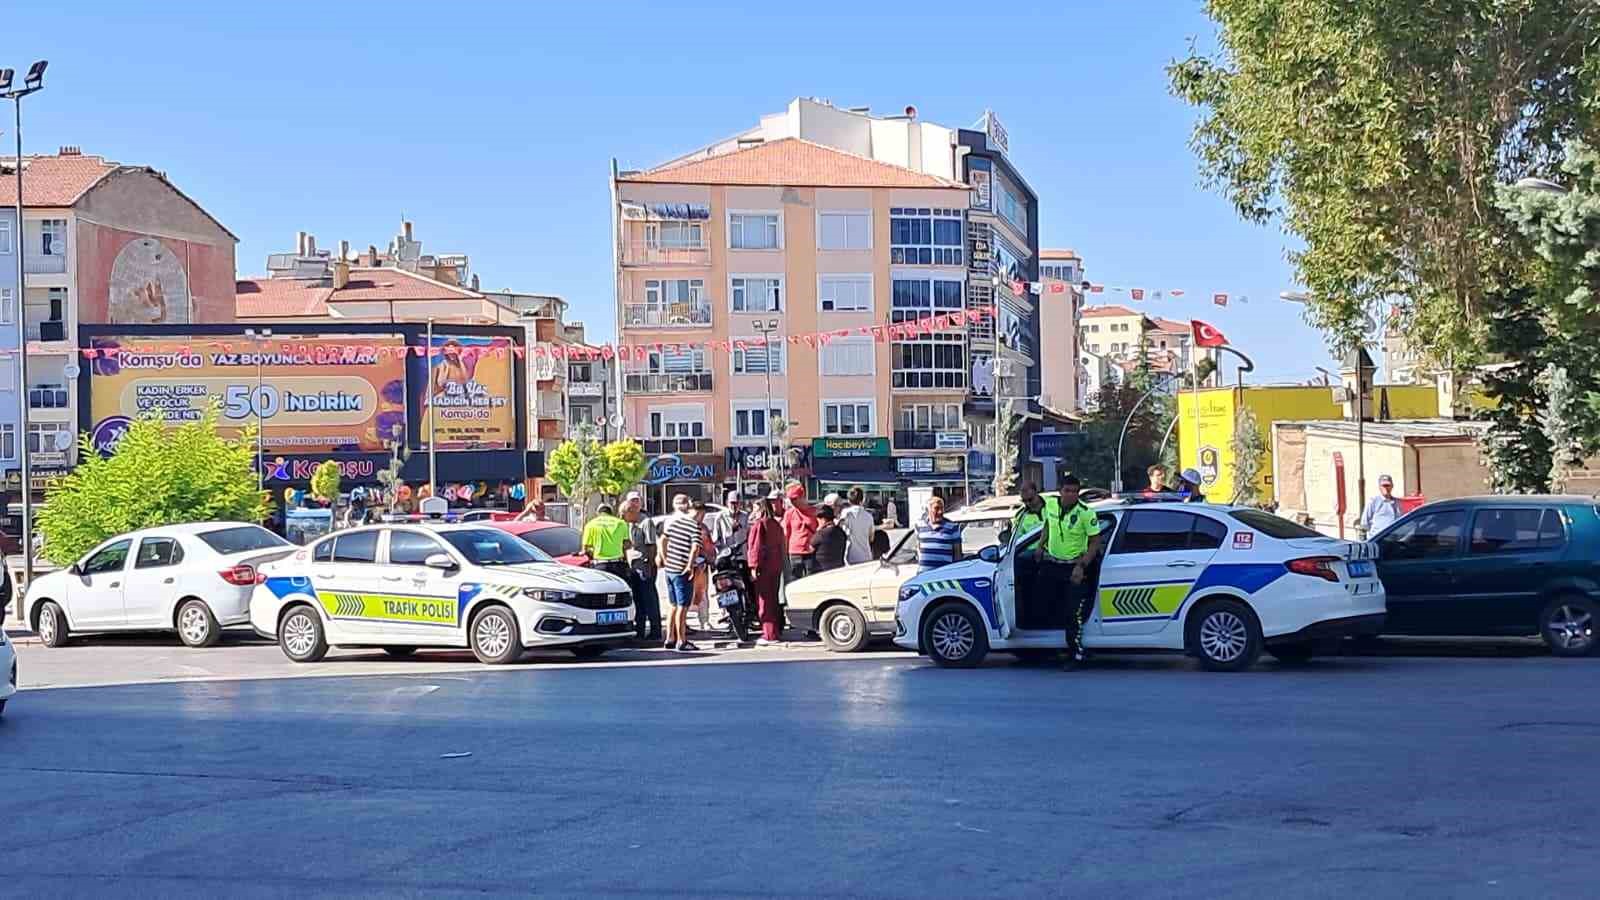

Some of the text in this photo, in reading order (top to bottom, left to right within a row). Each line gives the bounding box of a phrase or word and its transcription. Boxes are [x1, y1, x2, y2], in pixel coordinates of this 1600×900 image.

[119, 352, 203, 369] Komşu'da
[209, 353, 237, 365] YAZ
[242, 353, 312, 365] BOYUNCA
[175, 385, 206, 395] ERKEK
[138, 398, 151, 408] VE
[284, 390, 361, 412] İNDİRİM
[652, 464, 714, 478] MERCAN
[1236, 533, 1252, 543] 112
[384, 600, 454, 619] TRAFİK POLİSİ
